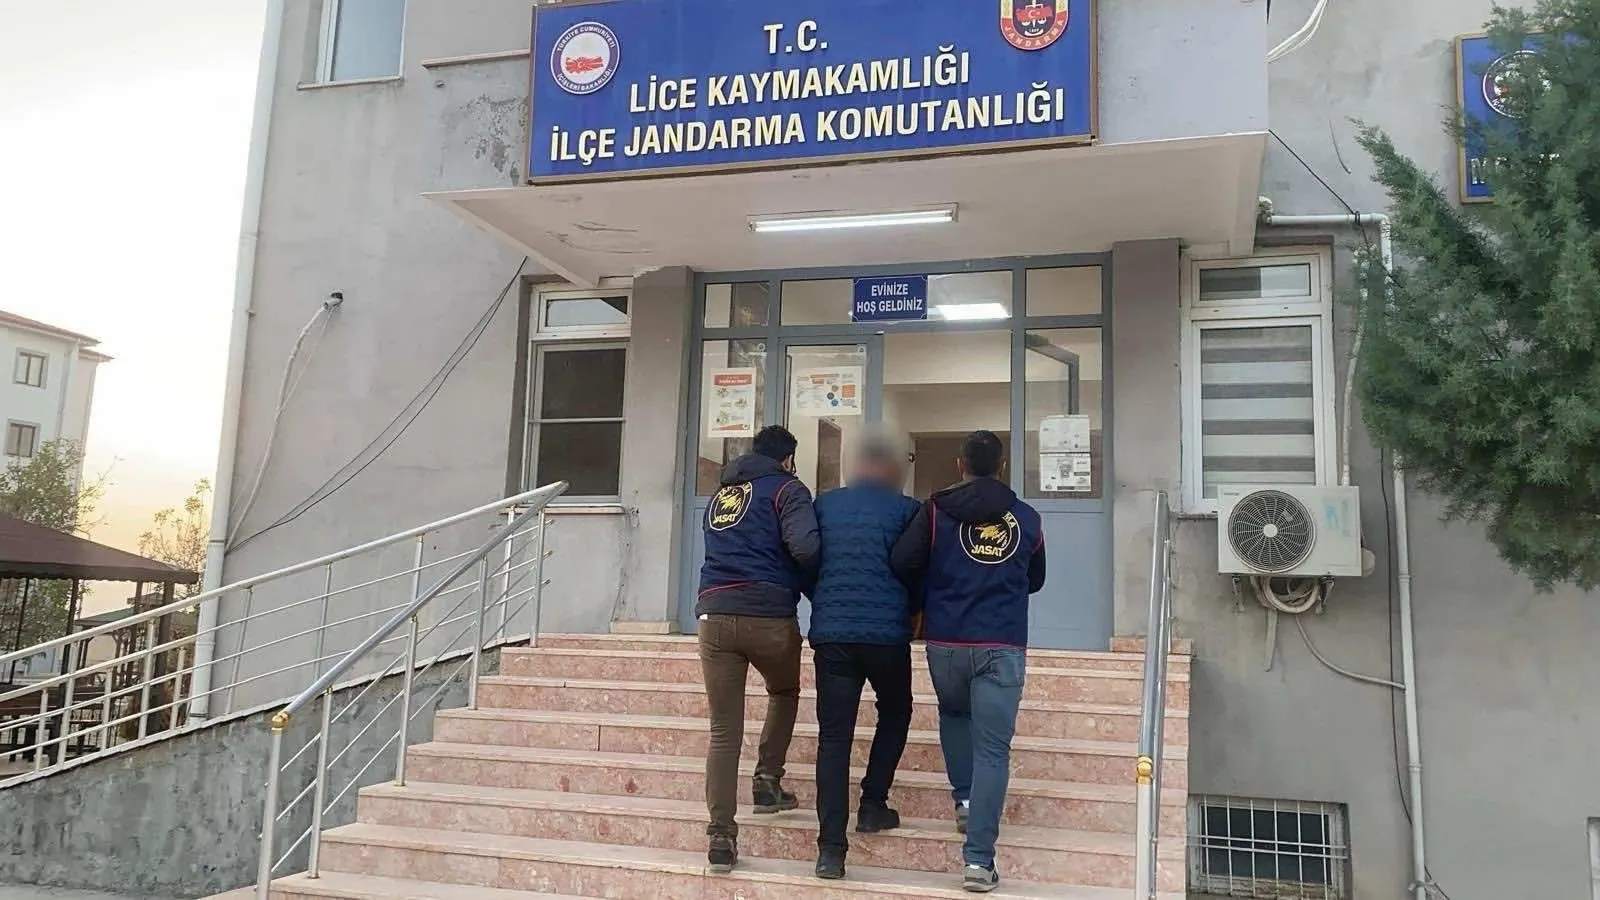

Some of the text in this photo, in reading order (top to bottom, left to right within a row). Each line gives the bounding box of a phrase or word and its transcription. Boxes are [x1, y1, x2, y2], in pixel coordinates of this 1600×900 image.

[763, 20, 828, 54] T.C.
[630, 44, 970, 113] LİCE KAYMAKAMLIĞI
[550, 80, 1064, 166] İLÇE JANDARMA KOMUTANLIĞI
[871, 281, 909, 297] EVİNİZE
[856, 296, 923, 316] HOŞ GELDİNİZ
[713, 513, 738, 524] JASAT
[971, 544, 1004, 557] JASAT
